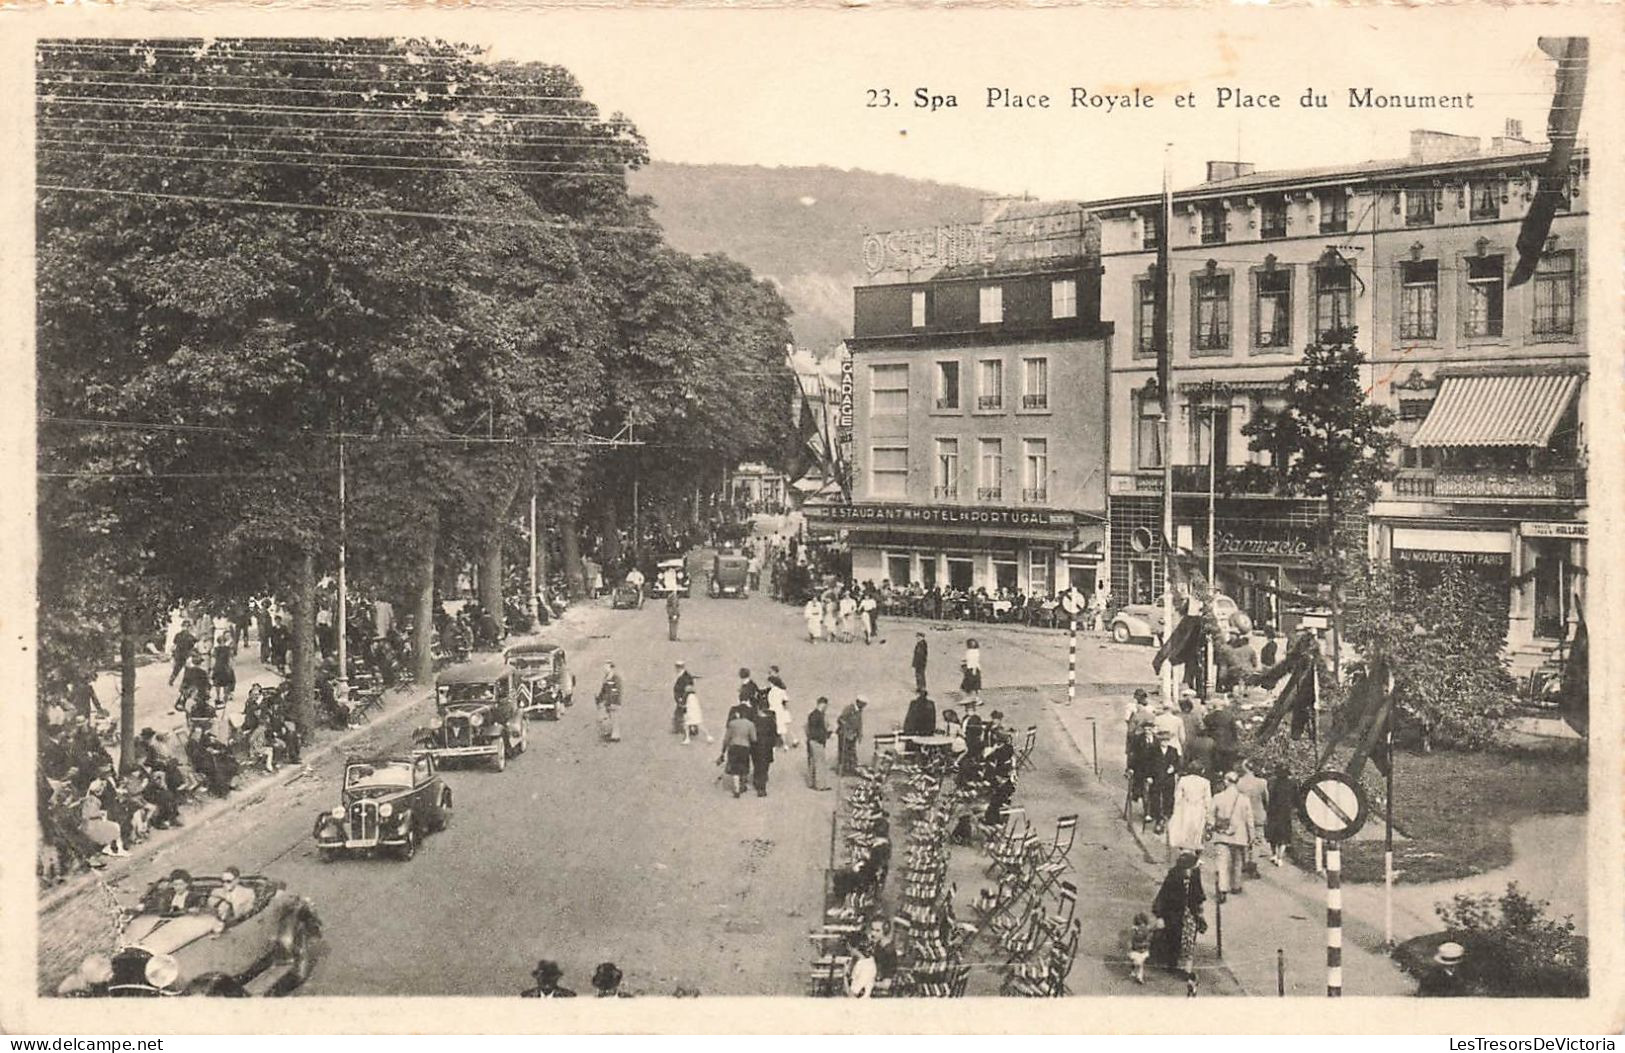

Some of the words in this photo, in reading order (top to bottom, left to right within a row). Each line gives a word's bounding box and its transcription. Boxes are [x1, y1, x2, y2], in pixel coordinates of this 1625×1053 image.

[842, 362, 853, 426] GARAGE
[821, 506, 902, 520] RESTAURANT
[912, 509, 959, 521] HOTEL
[970, 511, 1049, 524] PORTUGAL
